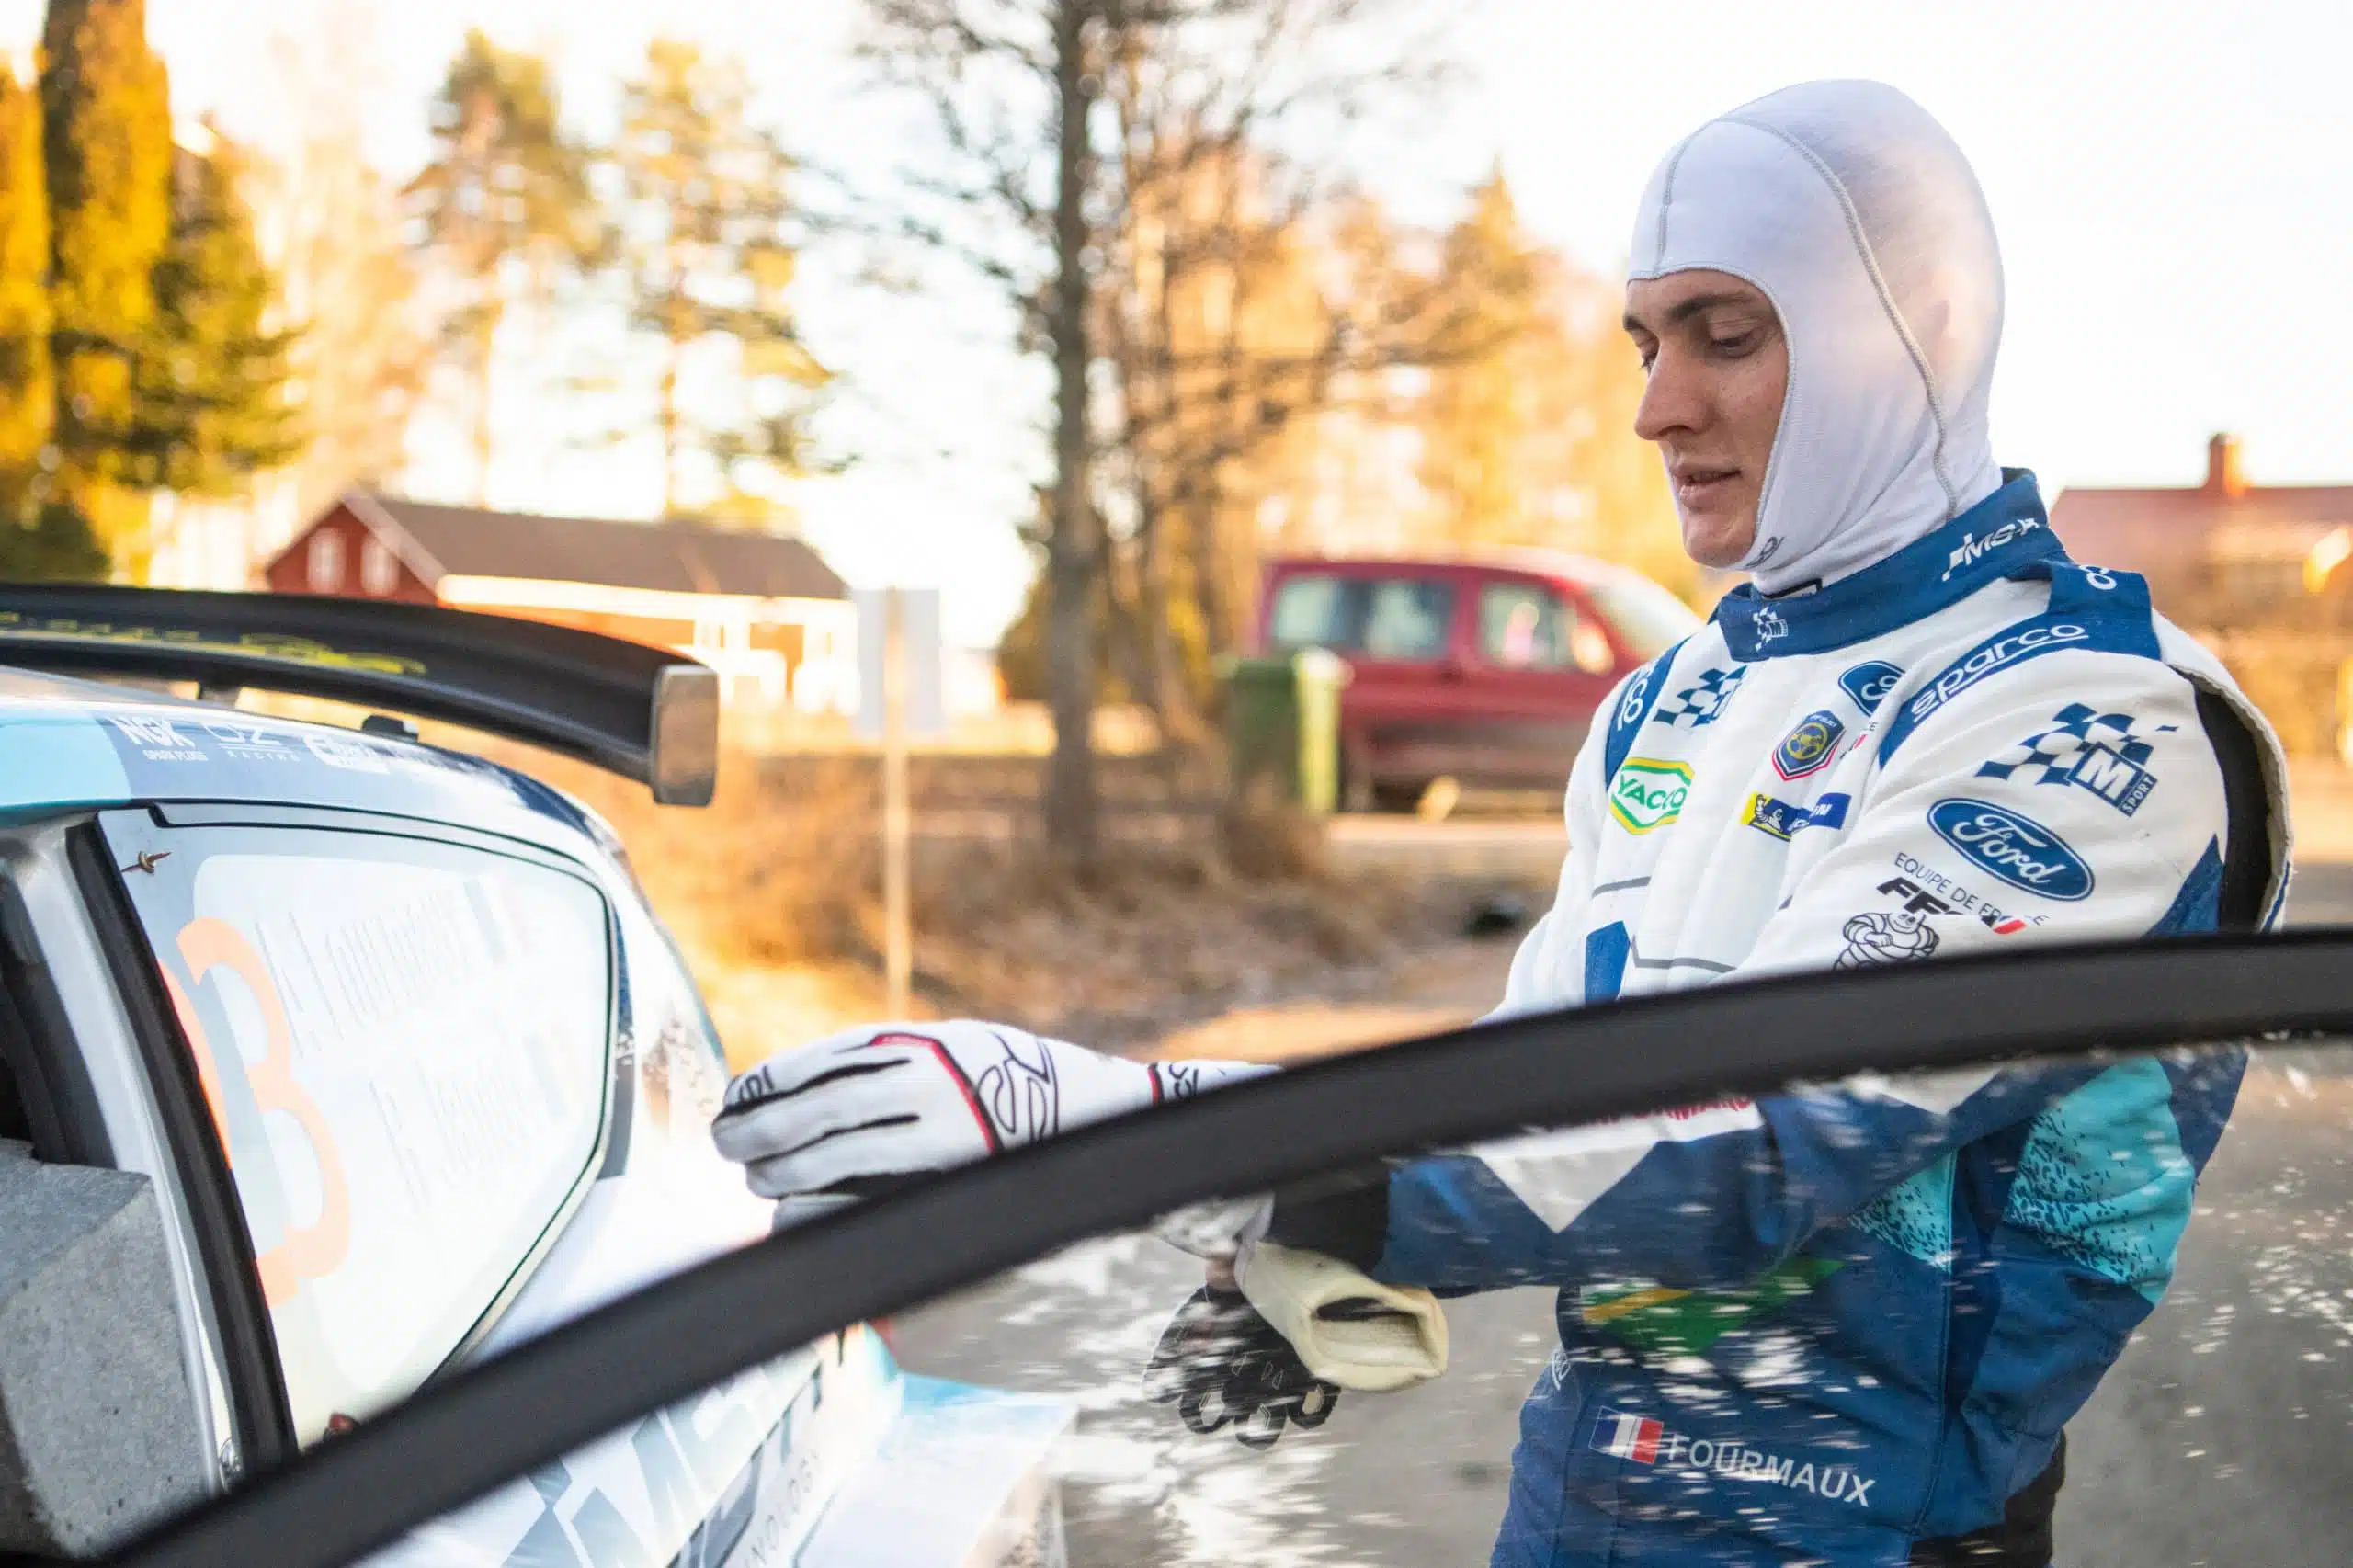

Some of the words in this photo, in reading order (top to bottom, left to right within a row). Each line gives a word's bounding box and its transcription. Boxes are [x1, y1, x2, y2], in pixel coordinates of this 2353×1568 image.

[1912, 624, 2086, 715] sparco
[2075, 747, 2137, 801] M
[2121, 776, 2155, 814] SPORT
[1893, 852, 1952, 894] EQUIPE
[1950, 887, 1978, 911] DE
[1951, 813, 2066, 885] Ford
[1665, 1434, 1876, 1507] FOURMAUX
